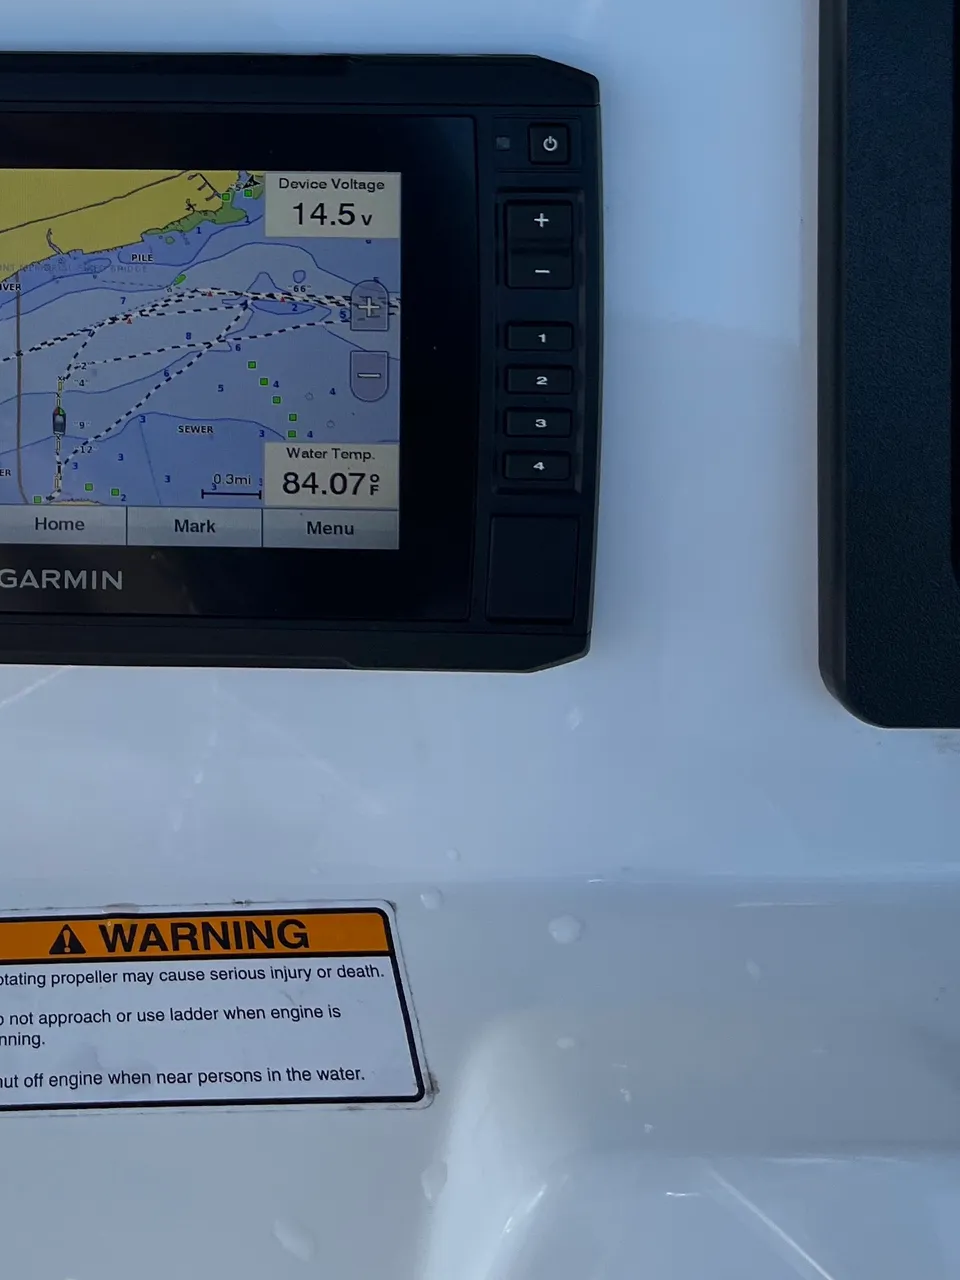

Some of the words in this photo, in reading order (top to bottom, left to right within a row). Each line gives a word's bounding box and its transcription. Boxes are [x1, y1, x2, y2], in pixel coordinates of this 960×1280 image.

[279, 178, 327, 190] Device
[332, 178, 385, 193] Voltage
[293, 203, 356, 226] 14.5
[131, 253, 154, 262] PILE
[538, 333, 546, 343] 1
[536, 376, 548, 386] 2
[178, 425, 214, 434] SEWER
[535, 419, 547, 428] 3
[286, 448, 328, 459] Water
[332, 449, 376, 463] Temp.
[533, 461, 545, 471] 4
[282, 472, 366, 495] 84.07
[35, 517, 85, 532] Home
[174, 519, 216, 534] Mark
[307, 521, 354, 536] Menu
[98, 918, 310, 953] WARNING
[50, 968, 118, 986] propeller
[122, 970, 155, 985] may
[159, 968, 205, 982] cause
[210, 966, 266, 981] serious
[270, 965, 312, 982] injury
[316, 967, 334, 979] or
[337, 964, 385, 979] death.
[9, 1012, 34, 1026] not
[38, 1008, 111, 1027] approach
[116, 1011, 132, 1023] or
[136, 1010, 165, 1023] use
[169, 1006, 219, 1021] ladder
[223, 1005, 266, 1020] when
[270, 1005, 324, 1022] engine
[328, 1004, 341, 1018] is
[24, 1073, 44, 1088] off
[49, 1071, 103, 1090] engine
[108, 1070, 151, 1085] when
[156, 1071, 193, 1084] near
[198, 1070, 262, 1086] persons
[266, 1067, 281, 1082] in
[285, 1067, 312, 1082] the
[314, 1066, 365, 1081] water.
